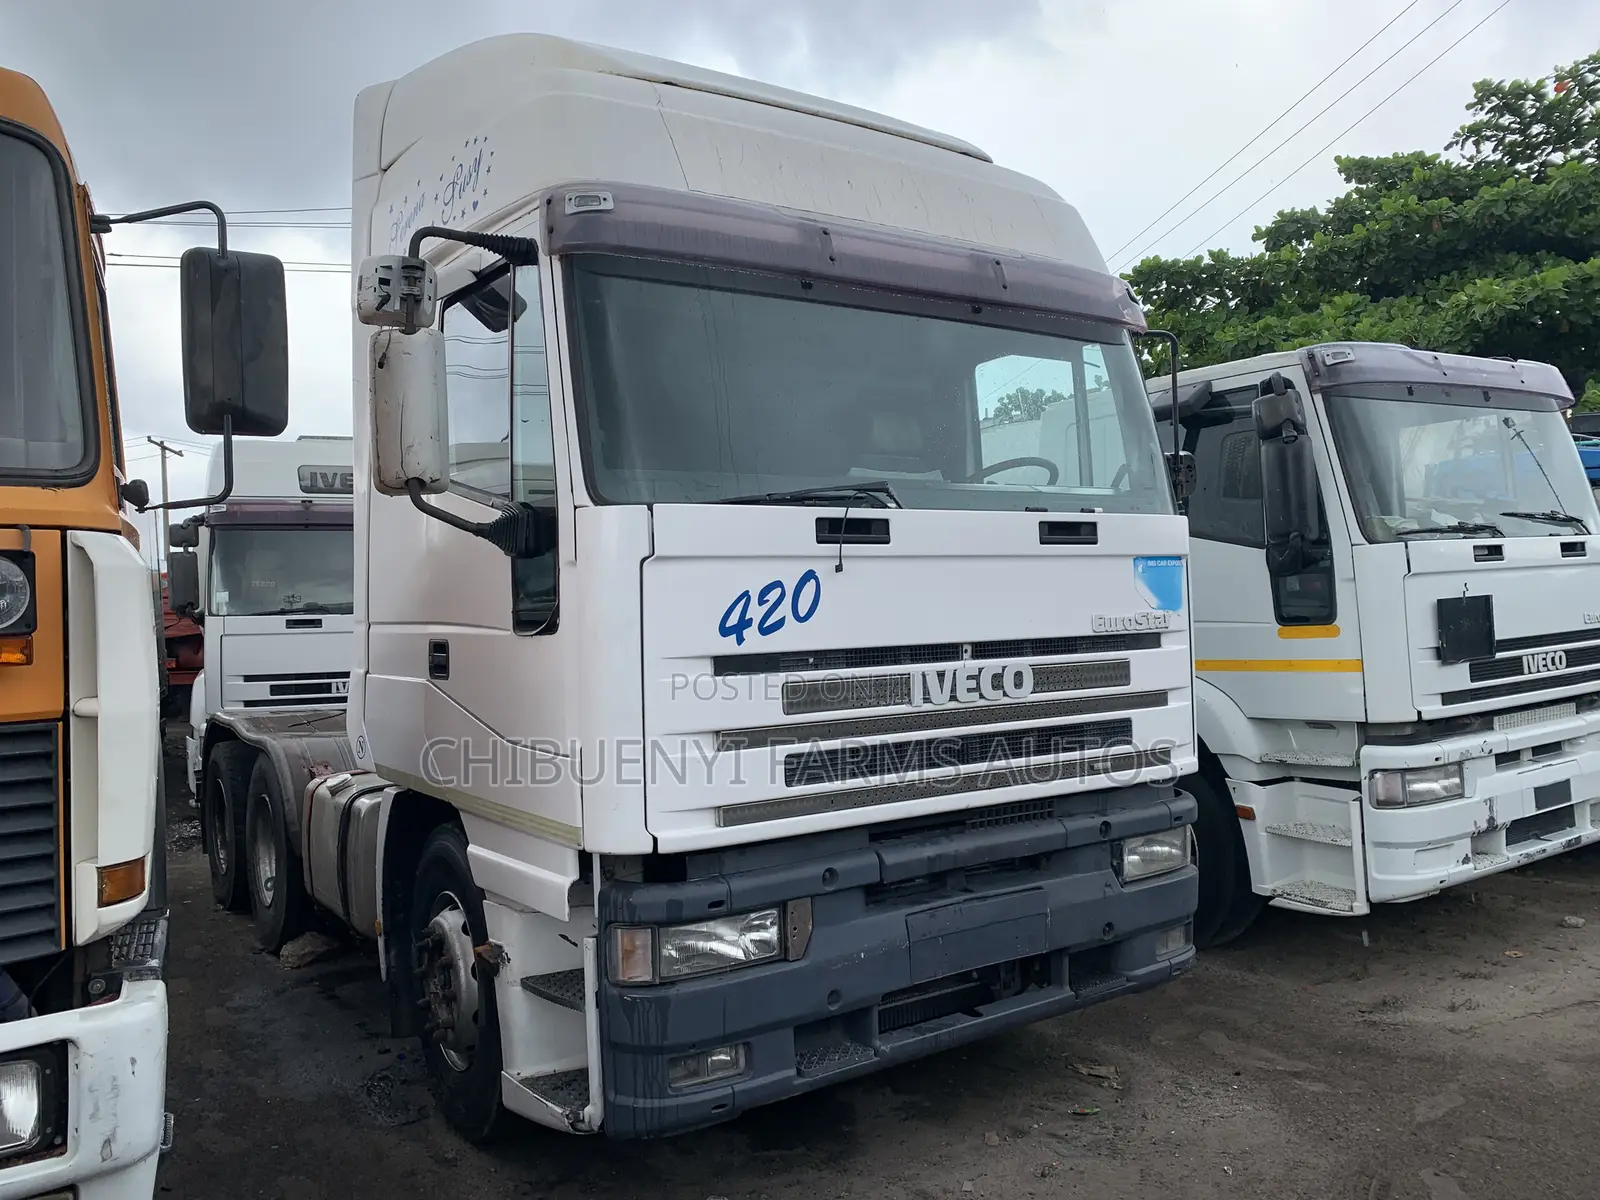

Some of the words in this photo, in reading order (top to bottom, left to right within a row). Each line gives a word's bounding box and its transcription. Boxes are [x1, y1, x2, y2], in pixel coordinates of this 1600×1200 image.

[718, 569, 821, 646] 420
[909, 663, 1034, 707] IVECO
[1522, 651, 1567, 675] IVECO
